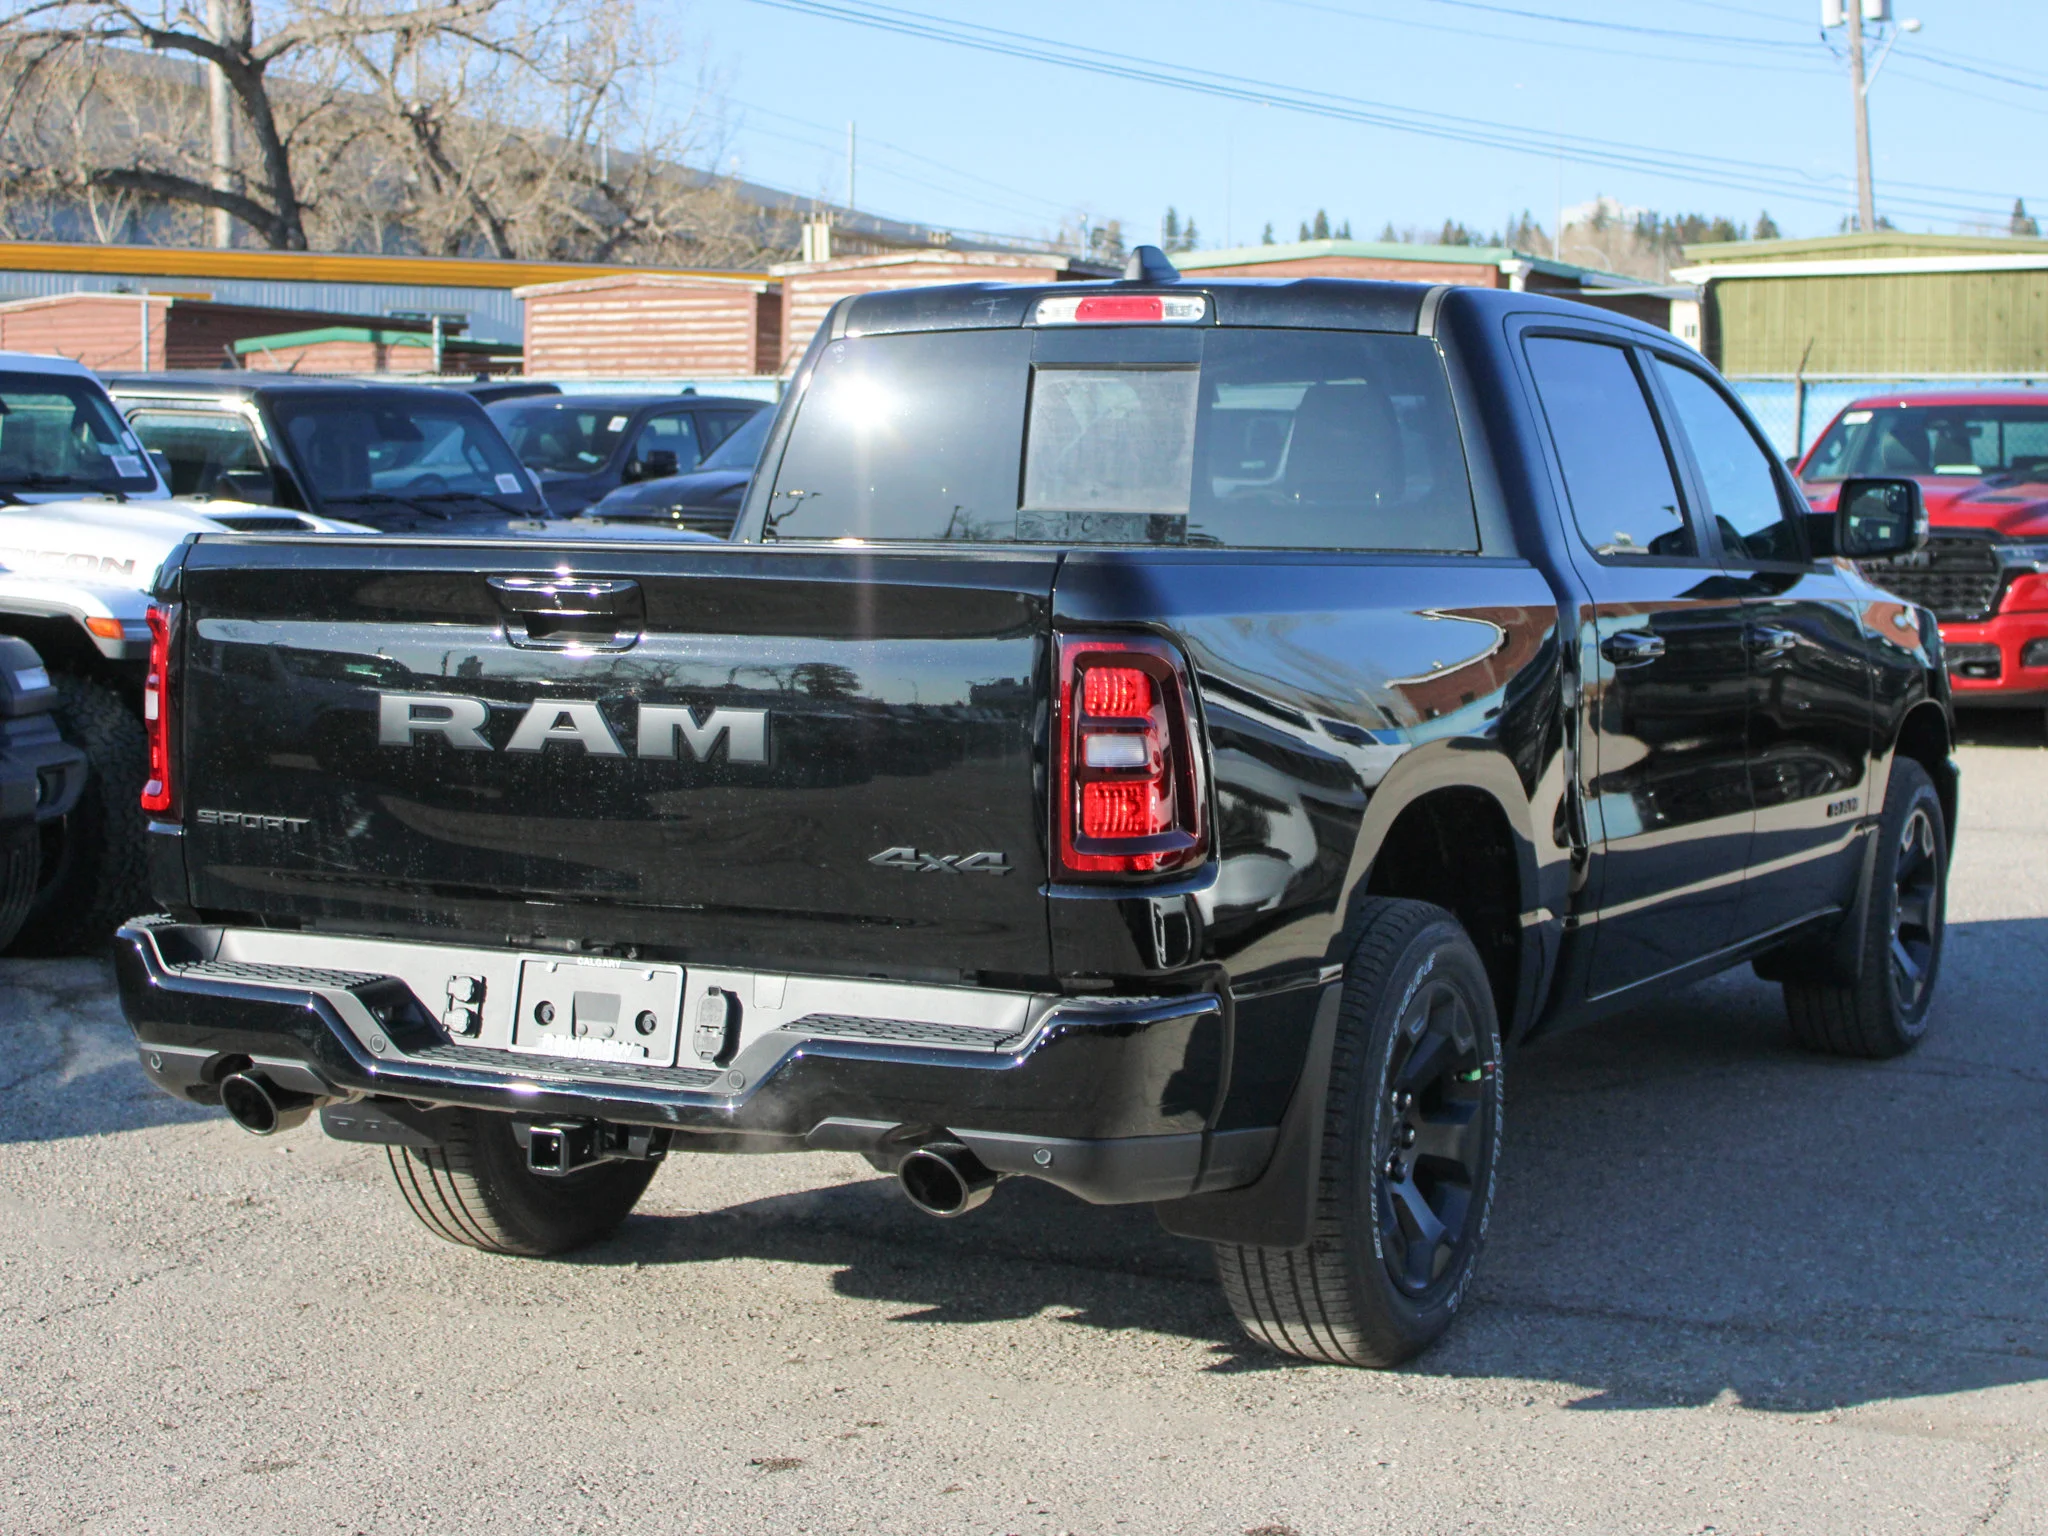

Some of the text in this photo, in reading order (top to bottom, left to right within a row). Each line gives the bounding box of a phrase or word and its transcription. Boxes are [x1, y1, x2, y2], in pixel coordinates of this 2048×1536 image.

[378, 692, 771, 766] RAM
[197, 809, 310, 833] SPORT
[576, 956, 621, 969] CALGARY
